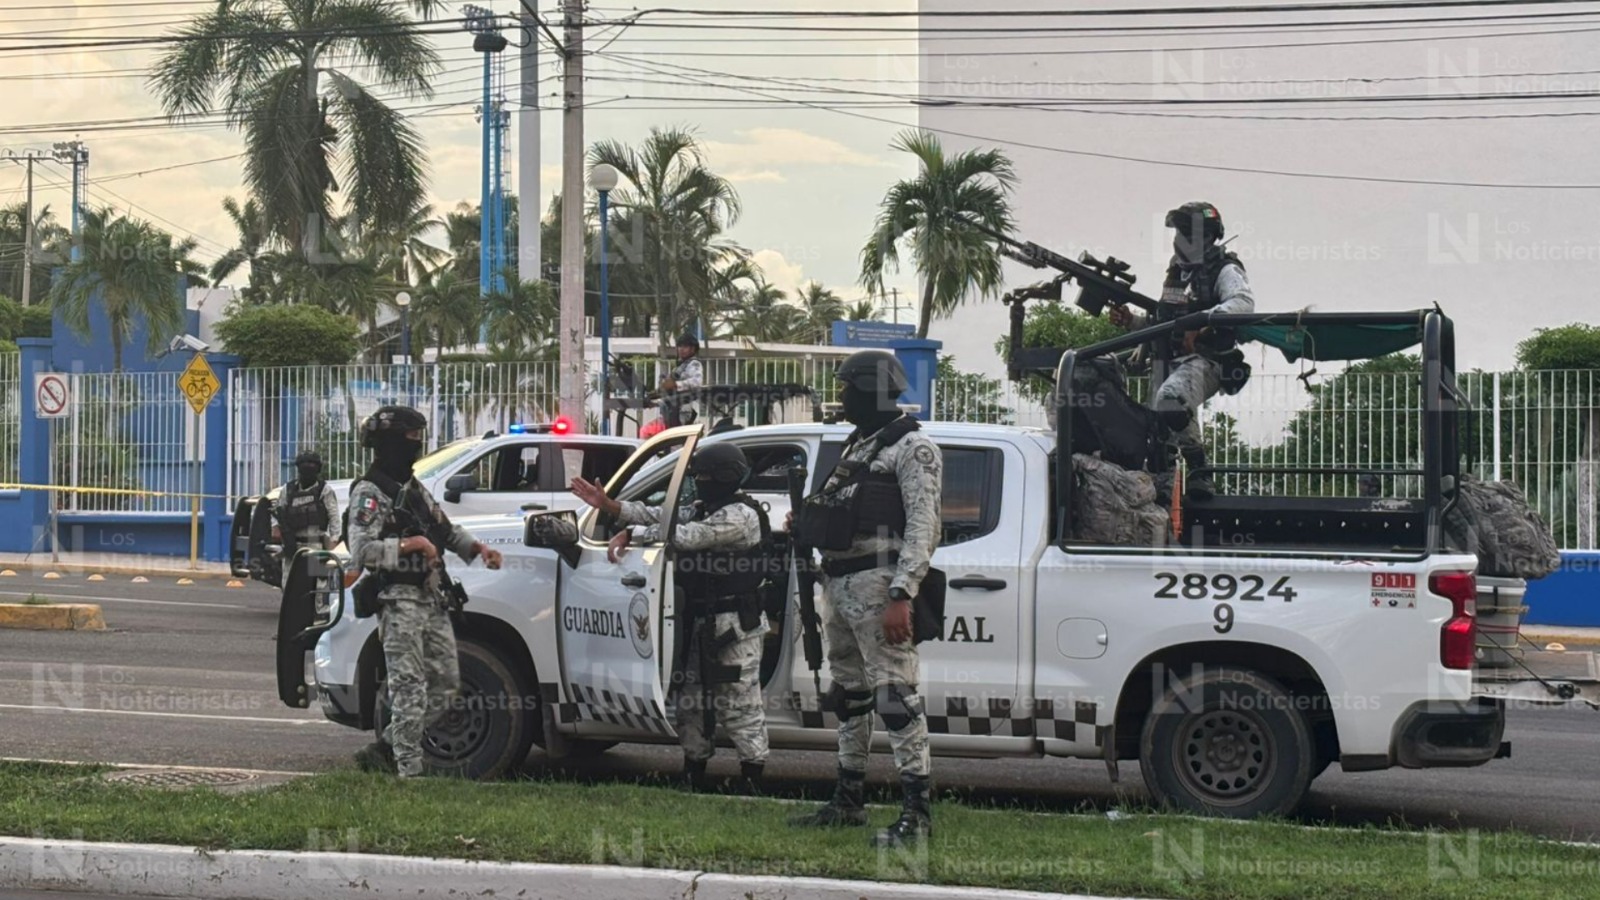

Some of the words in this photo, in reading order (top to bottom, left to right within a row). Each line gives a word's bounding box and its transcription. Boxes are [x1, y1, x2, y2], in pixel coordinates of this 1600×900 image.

[1154, 572, 1298, 602] 28924
[1374, 574, 1411, 586] 911
[563, 605, 626, 639] GUARDIA
[1213, 603, 1234, 634] 9
